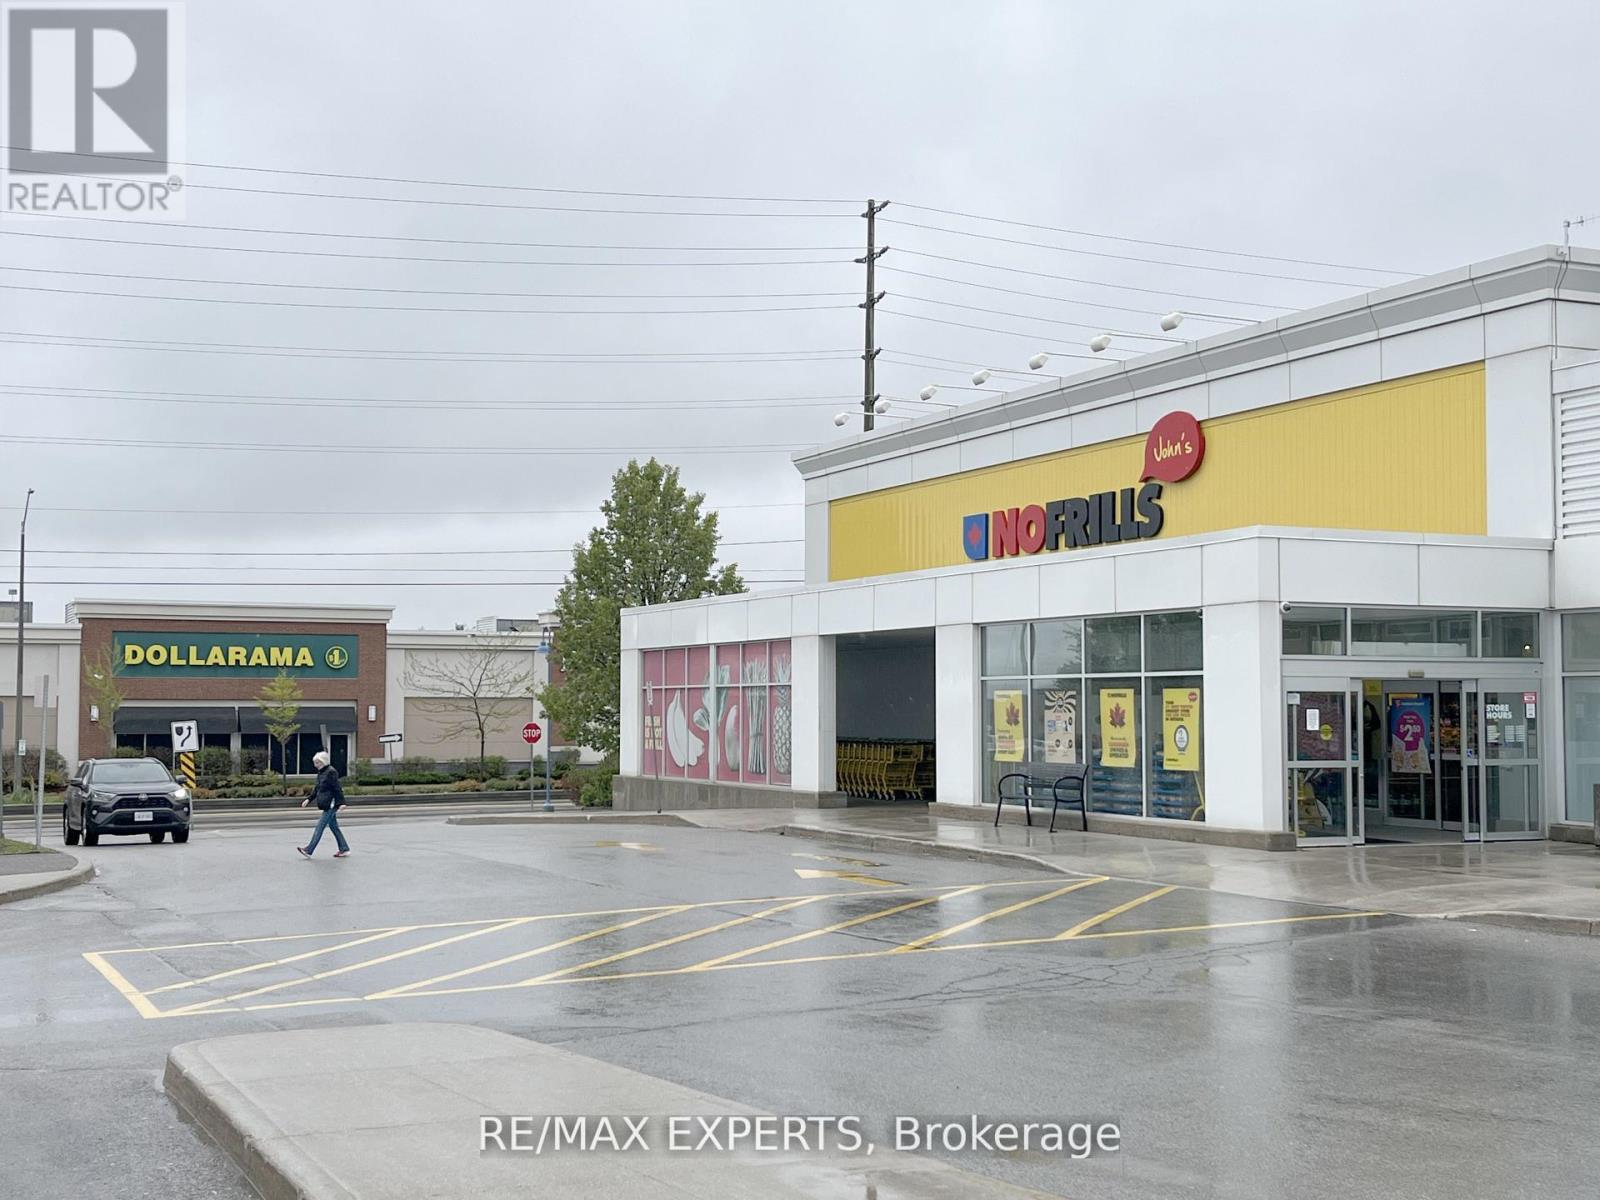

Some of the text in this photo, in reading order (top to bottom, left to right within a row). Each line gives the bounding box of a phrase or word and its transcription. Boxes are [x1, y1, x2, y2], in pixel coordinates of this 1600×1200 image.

[1153, 432, 1193, 463] John's
[124, 644, 315, 667] DOLLARAMA
[1486, 704, 1510, 712] STORE
[1486, 711, 1513, 719] HOURS
[644, 715, 661, 726] FRSH
[523, 728, 541, 738] STOP
